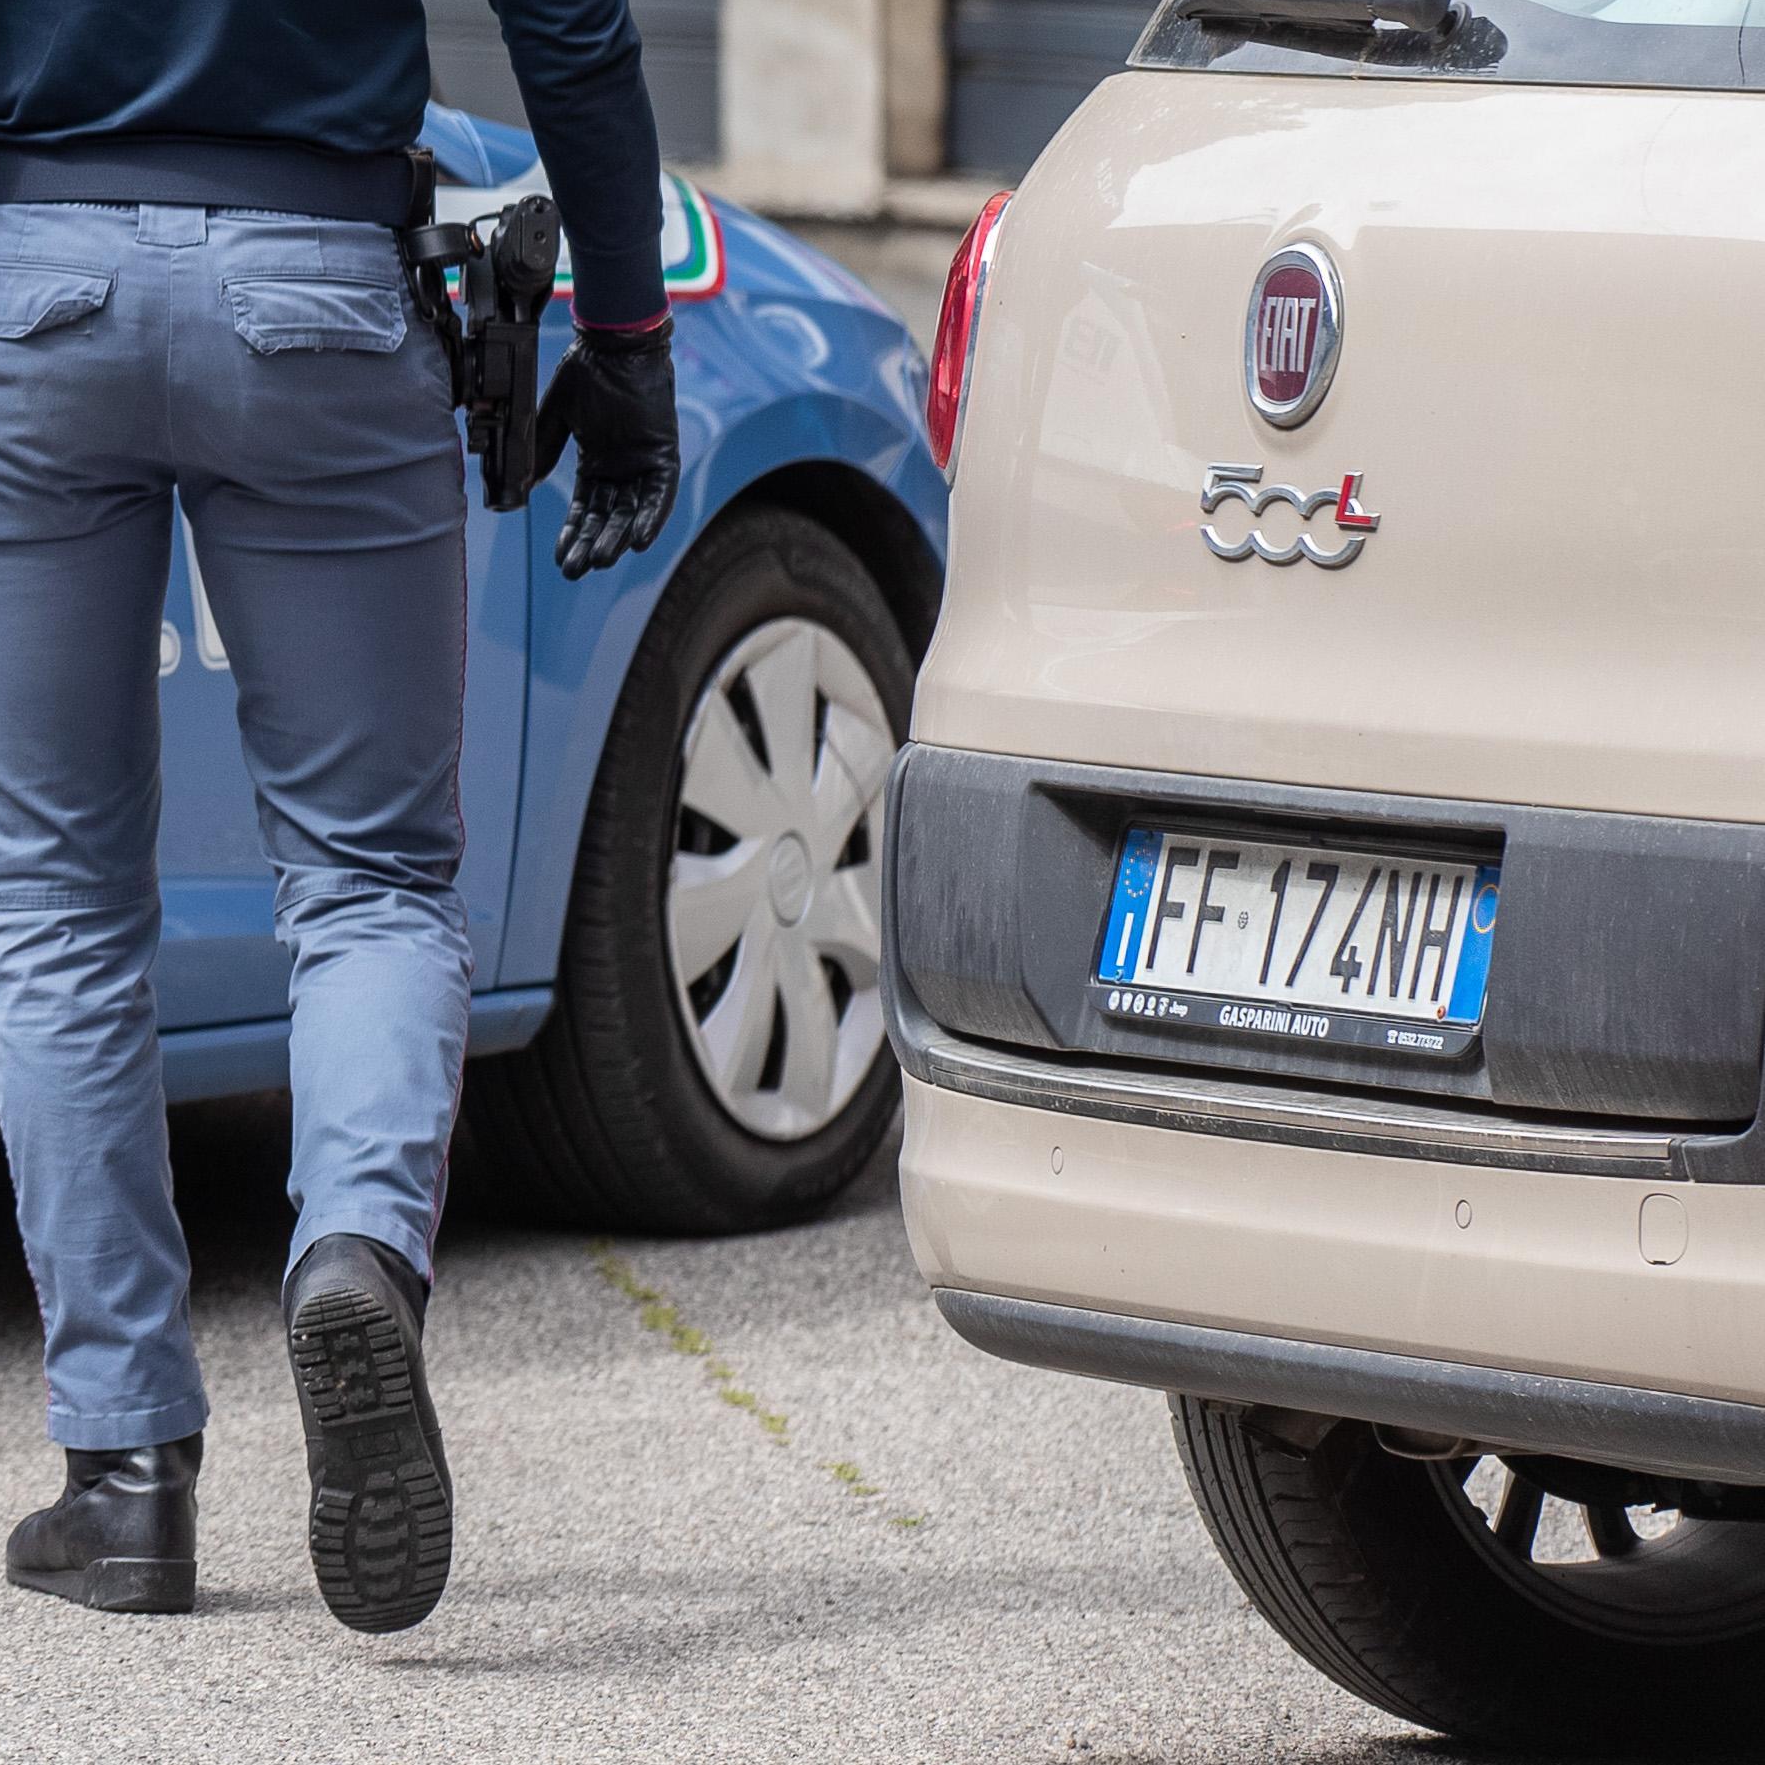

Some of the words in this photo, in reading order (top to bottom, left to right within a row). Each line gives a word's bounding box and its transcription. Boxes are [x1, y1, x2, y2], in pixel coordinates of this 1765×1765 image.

[1259, 295, 1318, 374] FIAT
[1169, 1002, 1188, 1017] Jeep
[1219, 1005, 1290, 1034] GASPARINI
[1290, 1014, 1330, 1038] AUTO
